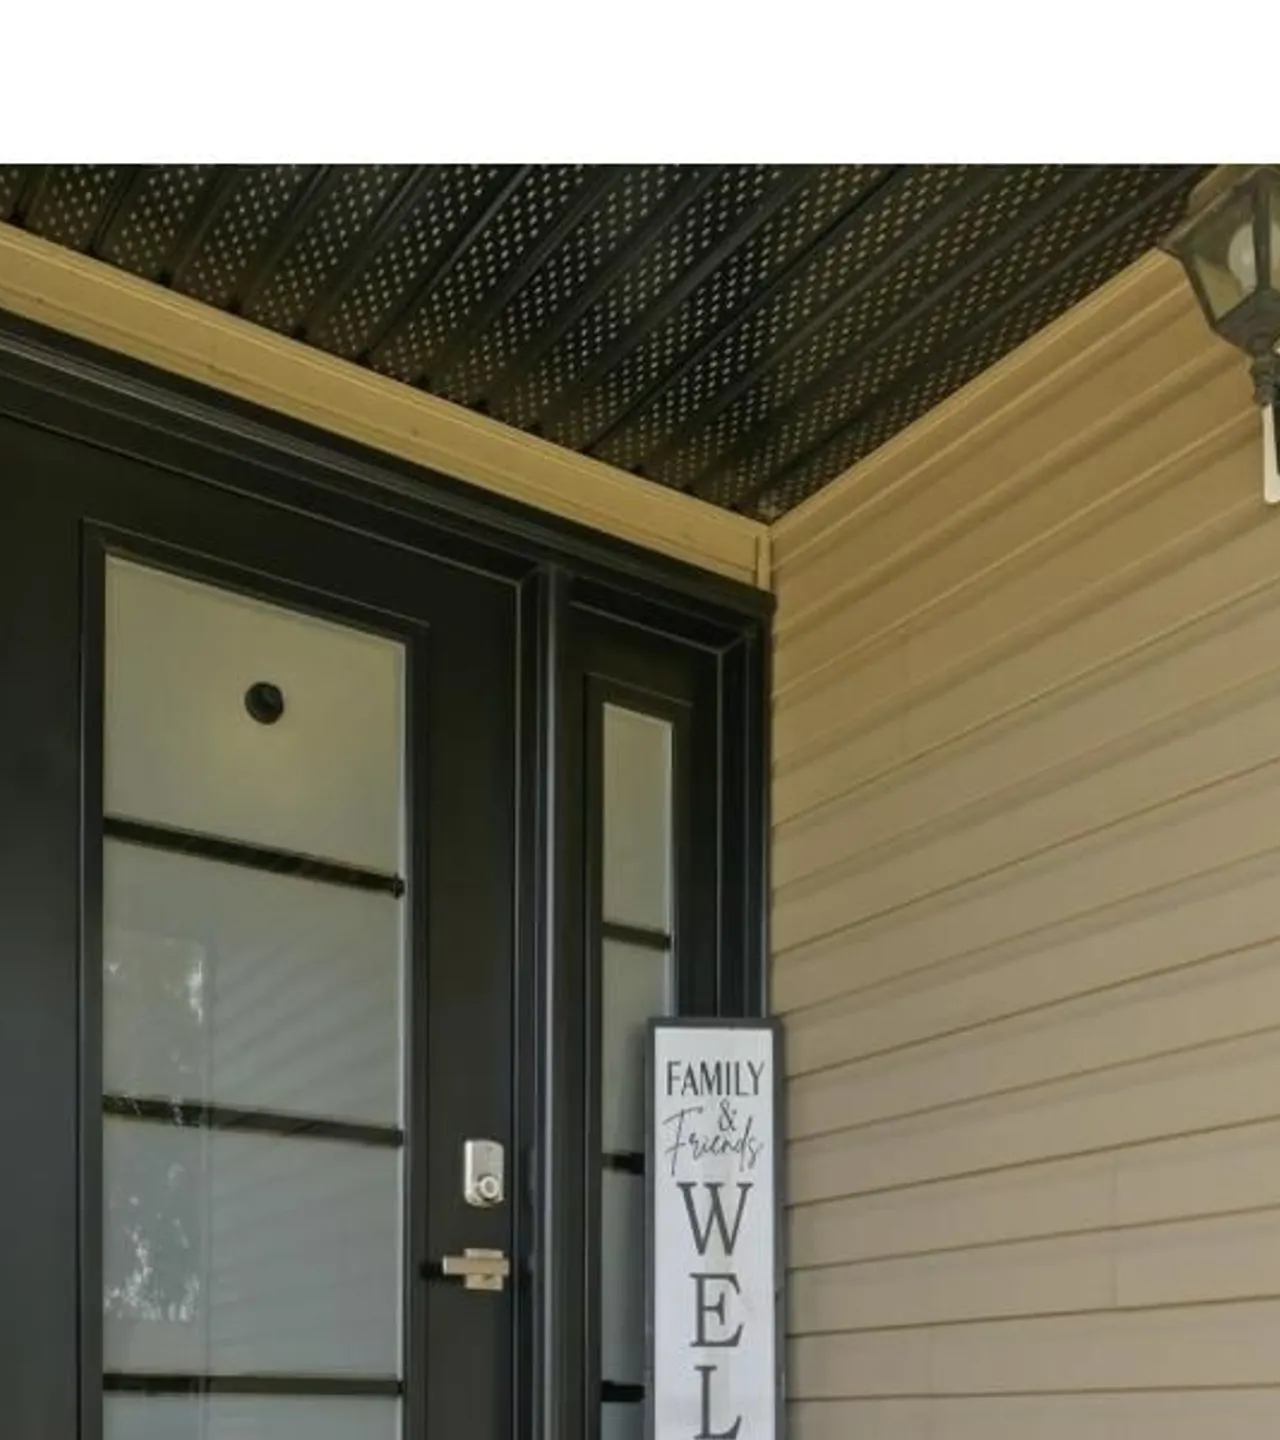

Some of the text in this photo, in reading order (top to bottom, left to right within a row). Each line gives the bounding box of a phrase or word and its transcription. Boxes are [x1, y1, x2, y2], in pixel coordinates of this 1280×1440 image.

[666, 1060, 765, 1096] FAMILY
[718, 1098, 737, 1132] &
[662, 1106, 763, 1177] Friends
